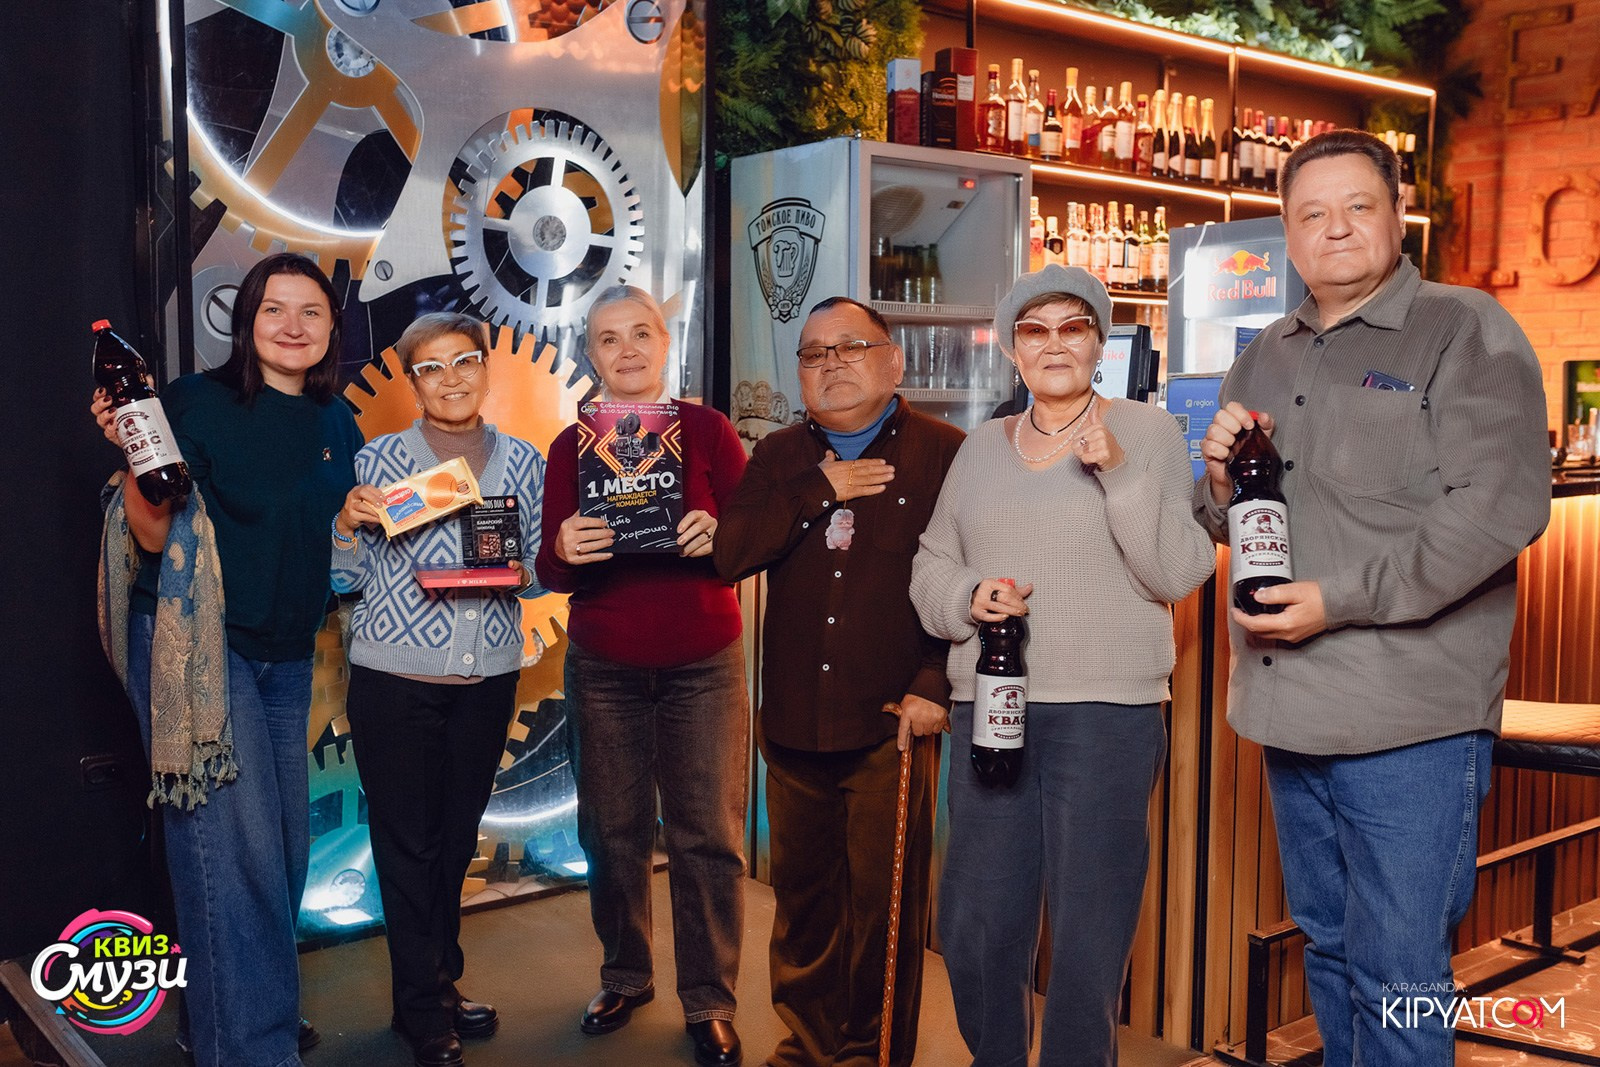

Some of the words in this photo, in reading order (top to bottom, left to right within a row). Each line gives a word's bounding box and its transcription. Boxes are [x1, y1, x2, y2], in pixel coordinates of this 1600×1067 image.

[756, 209, 791, 235] ТОМСКОЕ
[795, 209, 816, 229] ПИВО
[1208, 279, 1239, 301] Red
[1242, 276, 1276, 299] Bull
[1193, 399, 1214, 408] region
[587, 480, 599, 498] 1
[602, 471, 675, 497] МЕСТО
[606, 490, 657, 502] НАГРАЖДАЕТСЯ
[616, 498, 649, 508] КОМАНДА
[477, 518, 503, 526] БАВАРСКИЙ
[1240, 541, 1288, 554] КВАС
